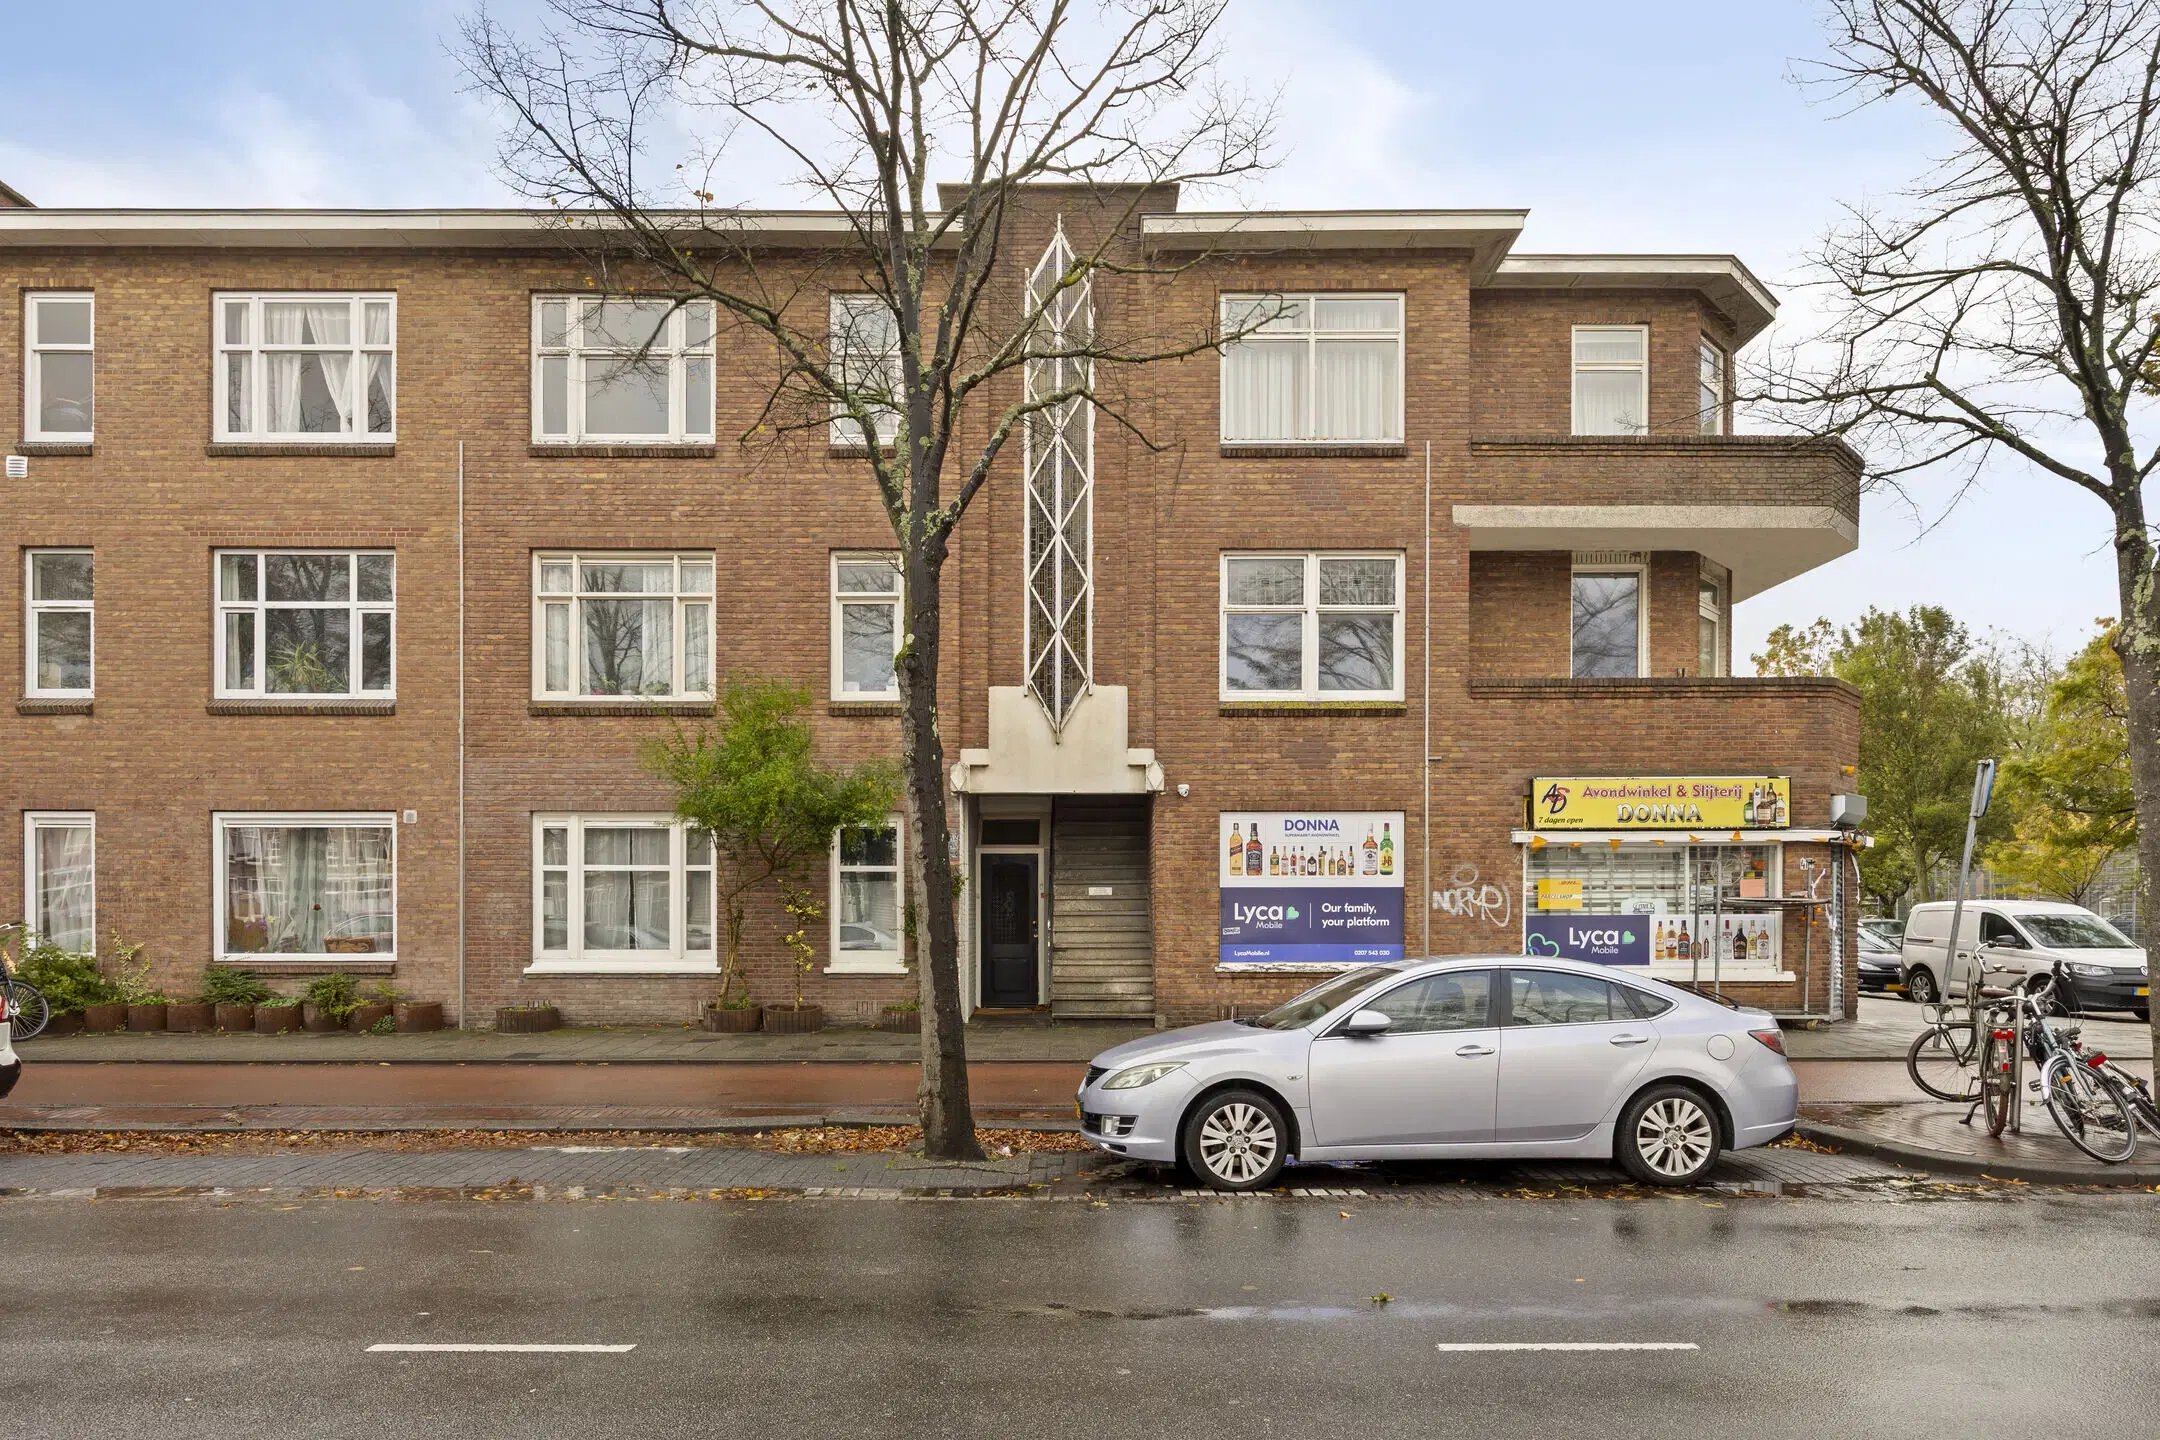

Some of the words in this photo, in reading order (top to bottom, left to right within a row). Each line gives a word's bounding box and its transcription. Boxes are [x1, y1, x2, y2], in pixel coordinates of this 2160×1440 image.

[1582, 785, 1671, 798] Avondwinkel
[1676, 784, 1688, 798] &
[1692, 784, 1744, 801] Slijterij
[1616, 803, 1704, 823] DONNA
[1284, 819, 1340, 831] DONNA
[1538, 816, 1544, 824] 7
[1544, 816, 1566, 825] dagen
[1566, 817, 1584, 825] open
[1234, 902, 1283, 924] Lyca
[1321, 902, 1342, 913] Our
[1344, 902, 1377, 915] family,
[1255, 921, 1283, 929] Mobile
[1321, 919, 1344, 929] your
[1346, 916, 1390, 929] platform
[1568, 927, 1619, 949] Lyca
[1591, 946, 1619, 954] Mobile
